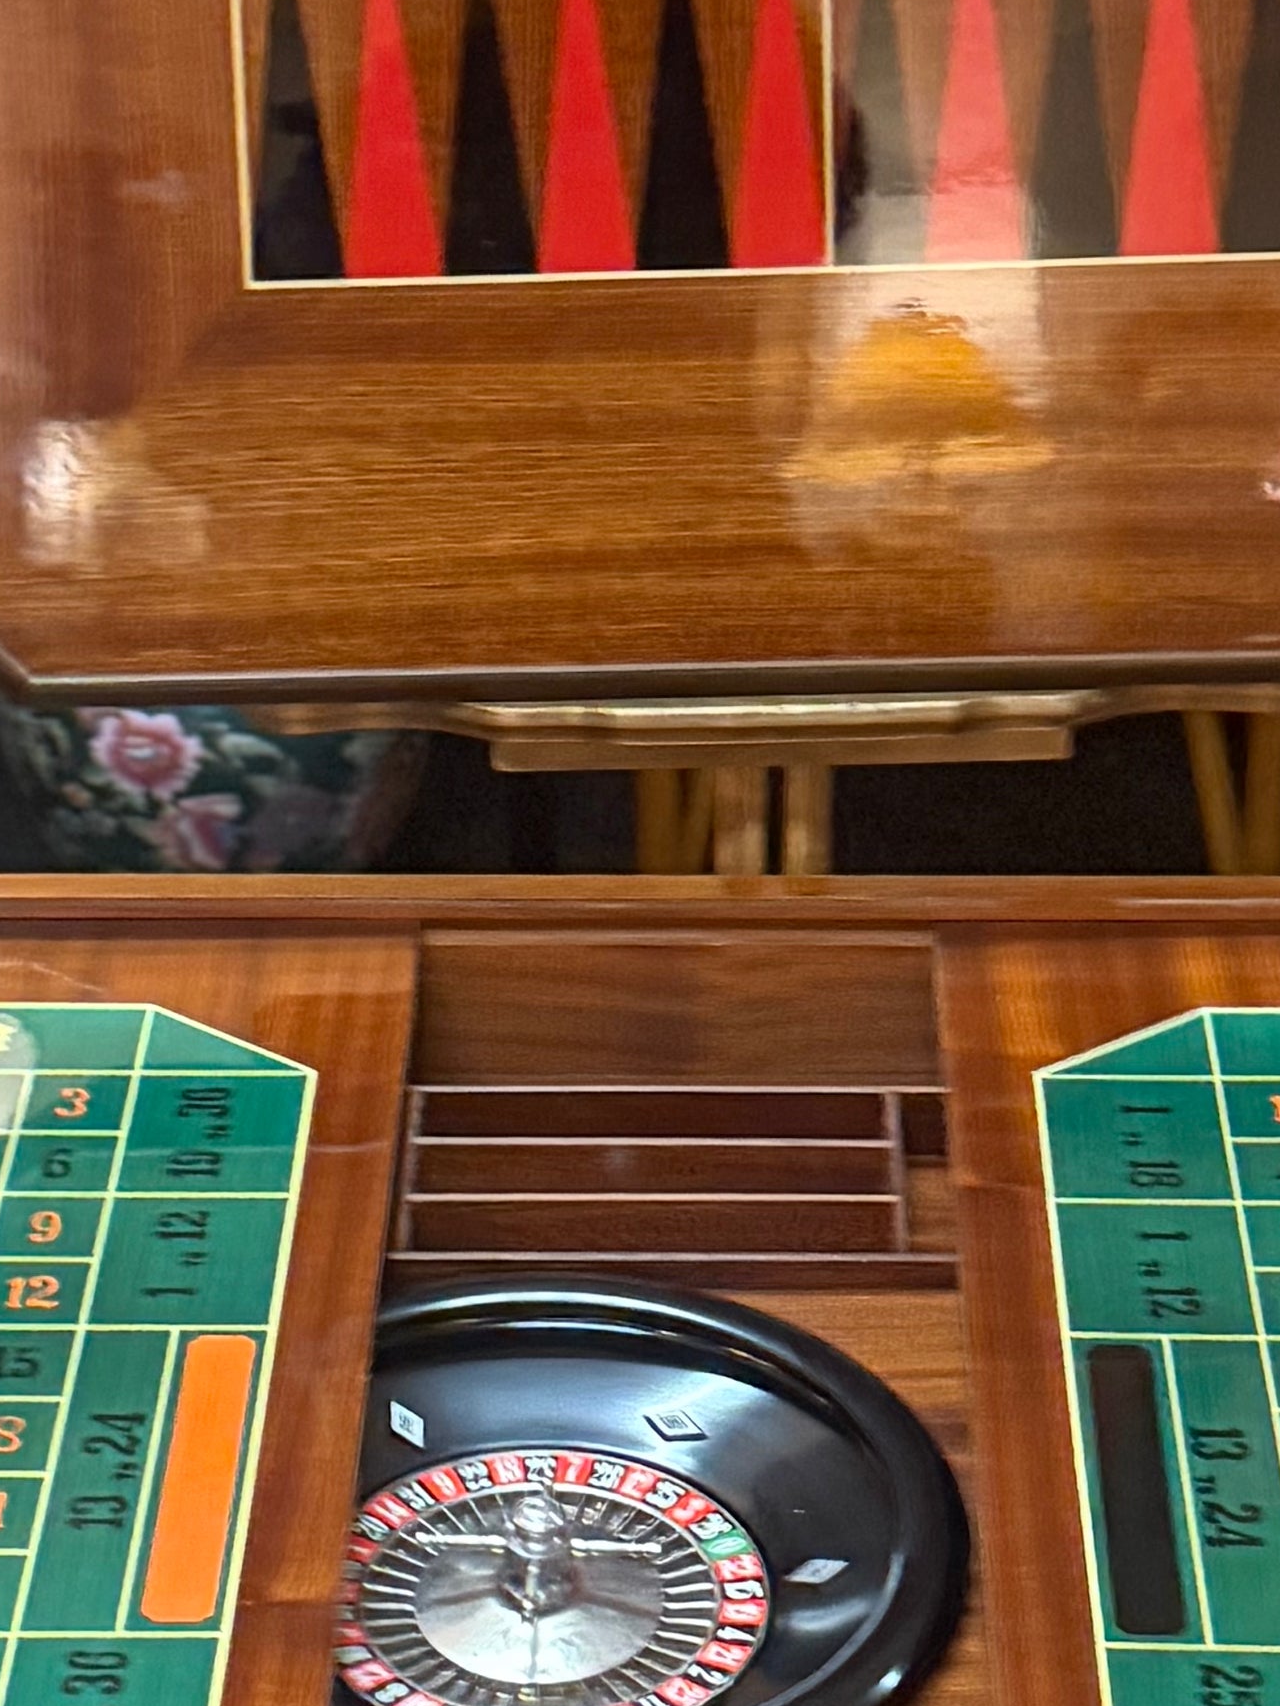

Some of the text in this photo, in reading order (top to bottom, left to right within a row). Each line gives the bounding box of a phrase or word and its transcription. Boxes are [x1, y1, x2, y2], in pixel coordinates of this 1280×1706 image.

[54, 1088, 89, 1118] 3
[41, 1147, 73, 1179] 6
[28, 1211, 62, 1244] 9
[6, 1275, 59, 1311] 12
[564, 1456, 586, 1485] 7
